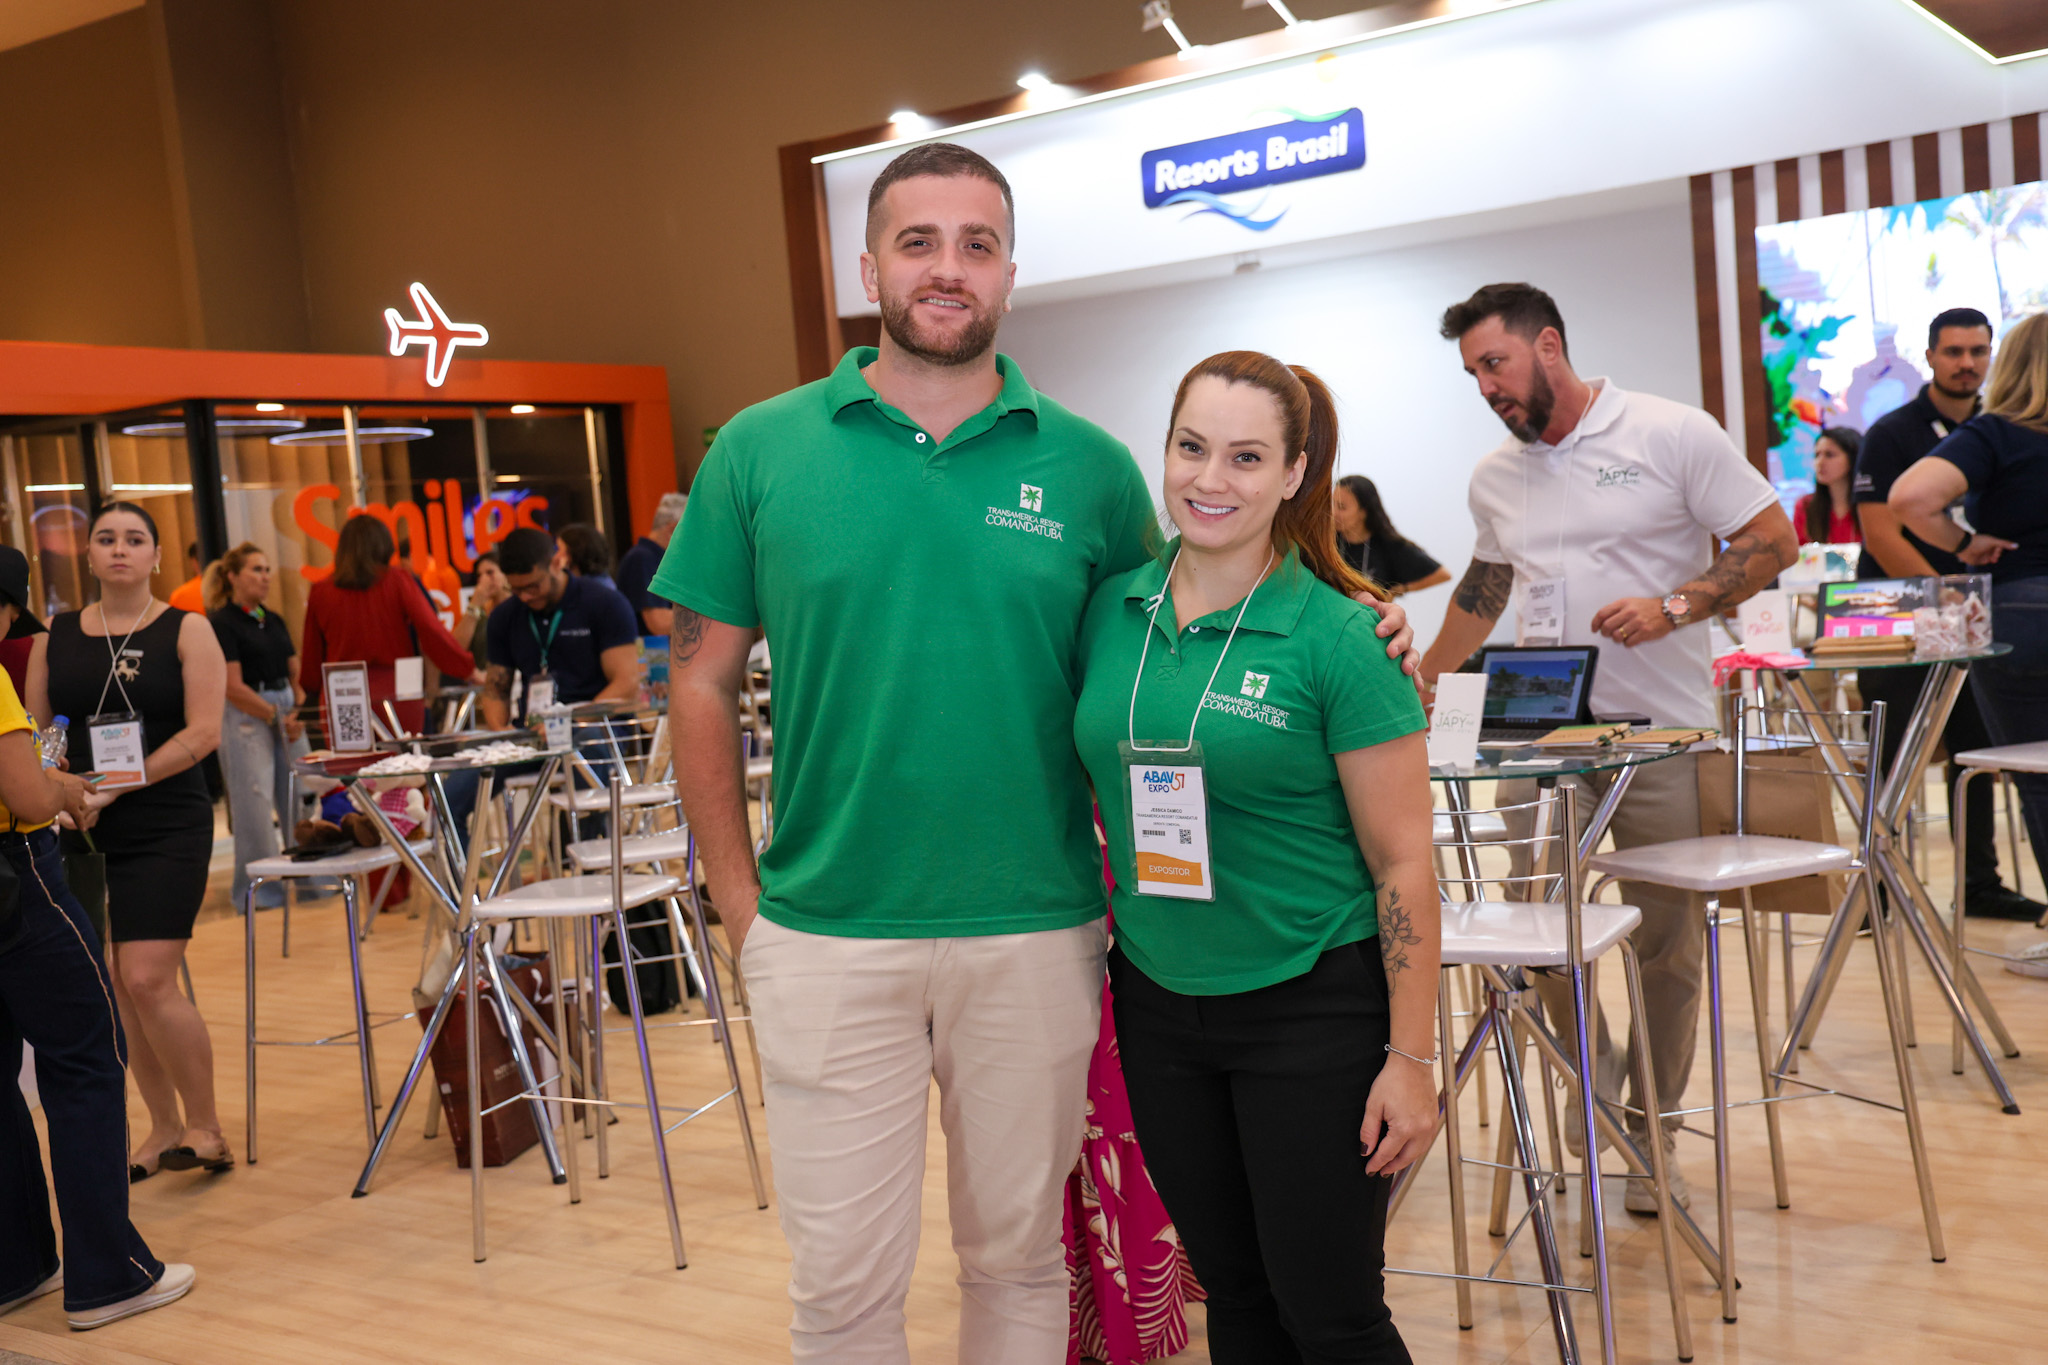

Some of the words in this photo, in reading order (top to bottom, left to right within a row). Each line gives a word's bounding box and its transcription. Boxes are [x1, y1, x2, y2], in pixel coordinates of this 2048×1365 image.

[1155, 149, 1260, 193] Resorts
[1266, 121, 1349, 171] Brasil
[293, 478, 549, 583] Smiles
[985, 513, 1064, 542] COMANDATUBA
[986, 506, 1039, 524] TRANSAMERICA
[1040, 517, 1065, 532] RESORT
[1202, 697, 1288, 730] COMANDATUBA
[1206, 691, 1260, 711] TRANSAMERICA
[1262, 703, 1290, 720] RESORT
[1143, 770, 1174, 784] ABAV
[1148, 784, 1170, 793] EXPO
[1148, 865, 1191, 877] EXPOSITOR
